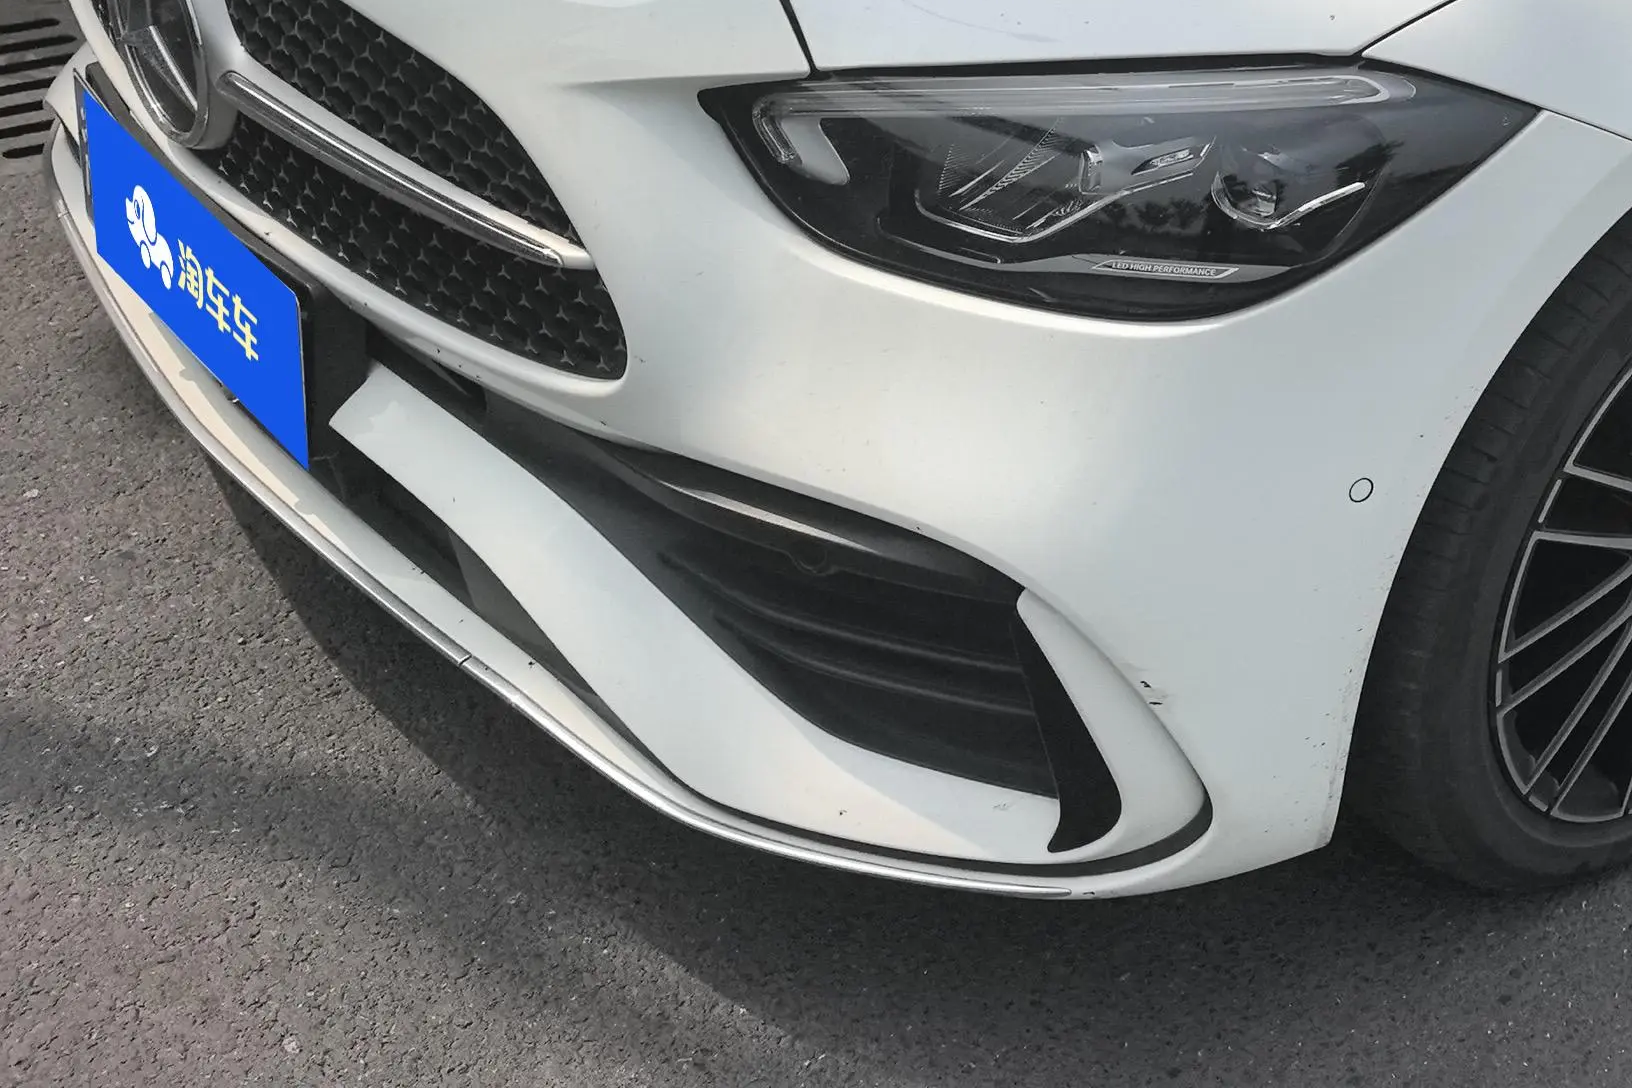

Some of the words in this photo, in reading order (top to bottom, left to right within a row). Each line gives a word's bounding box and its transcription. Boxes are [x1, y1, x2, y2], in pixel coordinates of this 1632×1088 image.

[1111, 261, 1129, 270] LED
[1130, 262, 1151, 272] HIGH
[1153, 264, 1217, 276] PERFORMANCE
